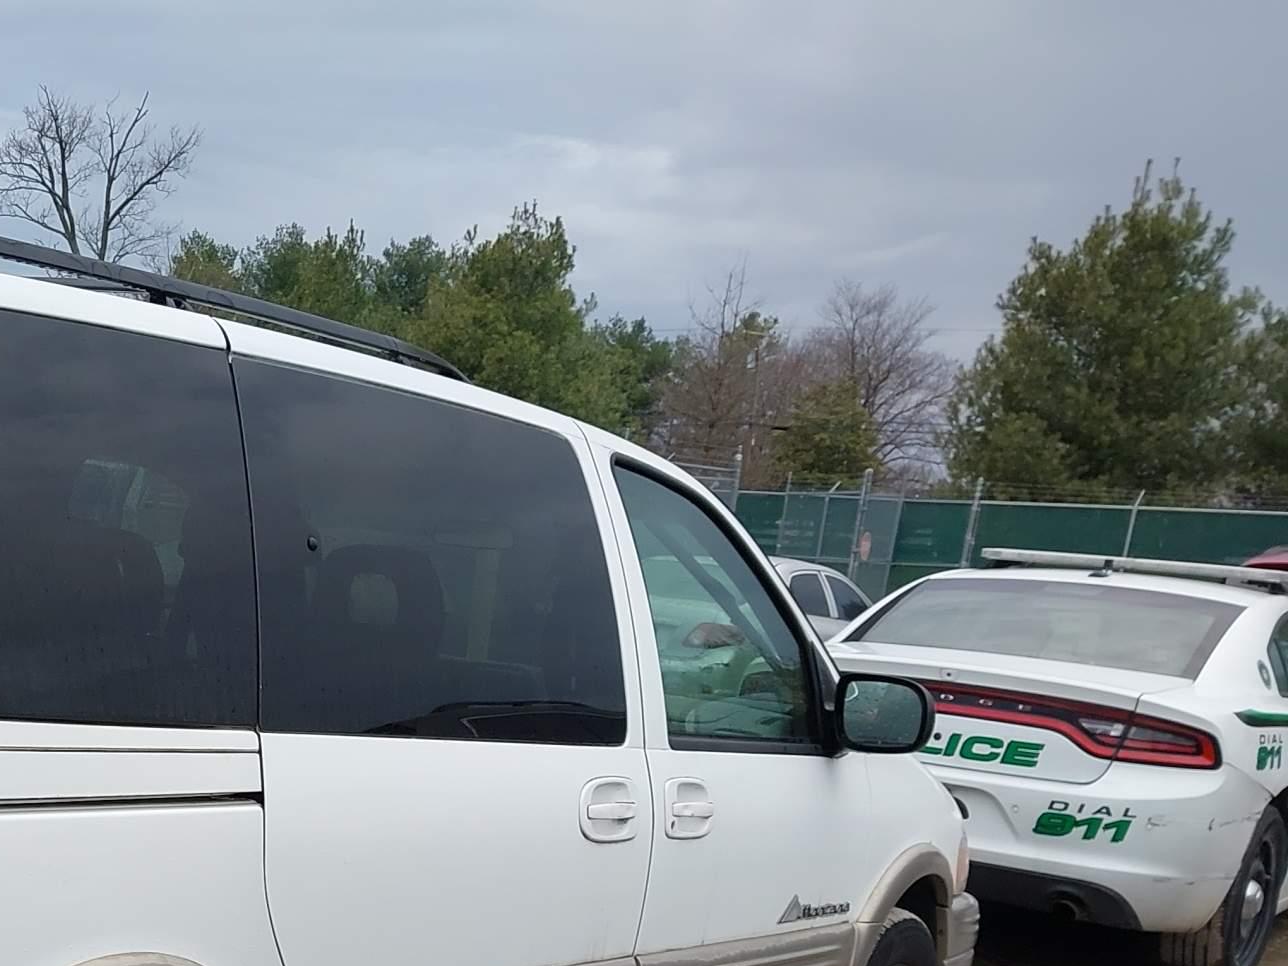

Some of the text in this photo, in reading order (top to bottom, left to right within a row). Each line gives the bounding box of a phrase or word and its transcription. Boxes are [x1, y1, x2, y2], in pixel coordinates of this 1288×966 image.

[1259, 734, 1283, 745] DIAL
[1048, 800, 1137, 818] DIAL
[1032, 812, 1133, 843] 911
